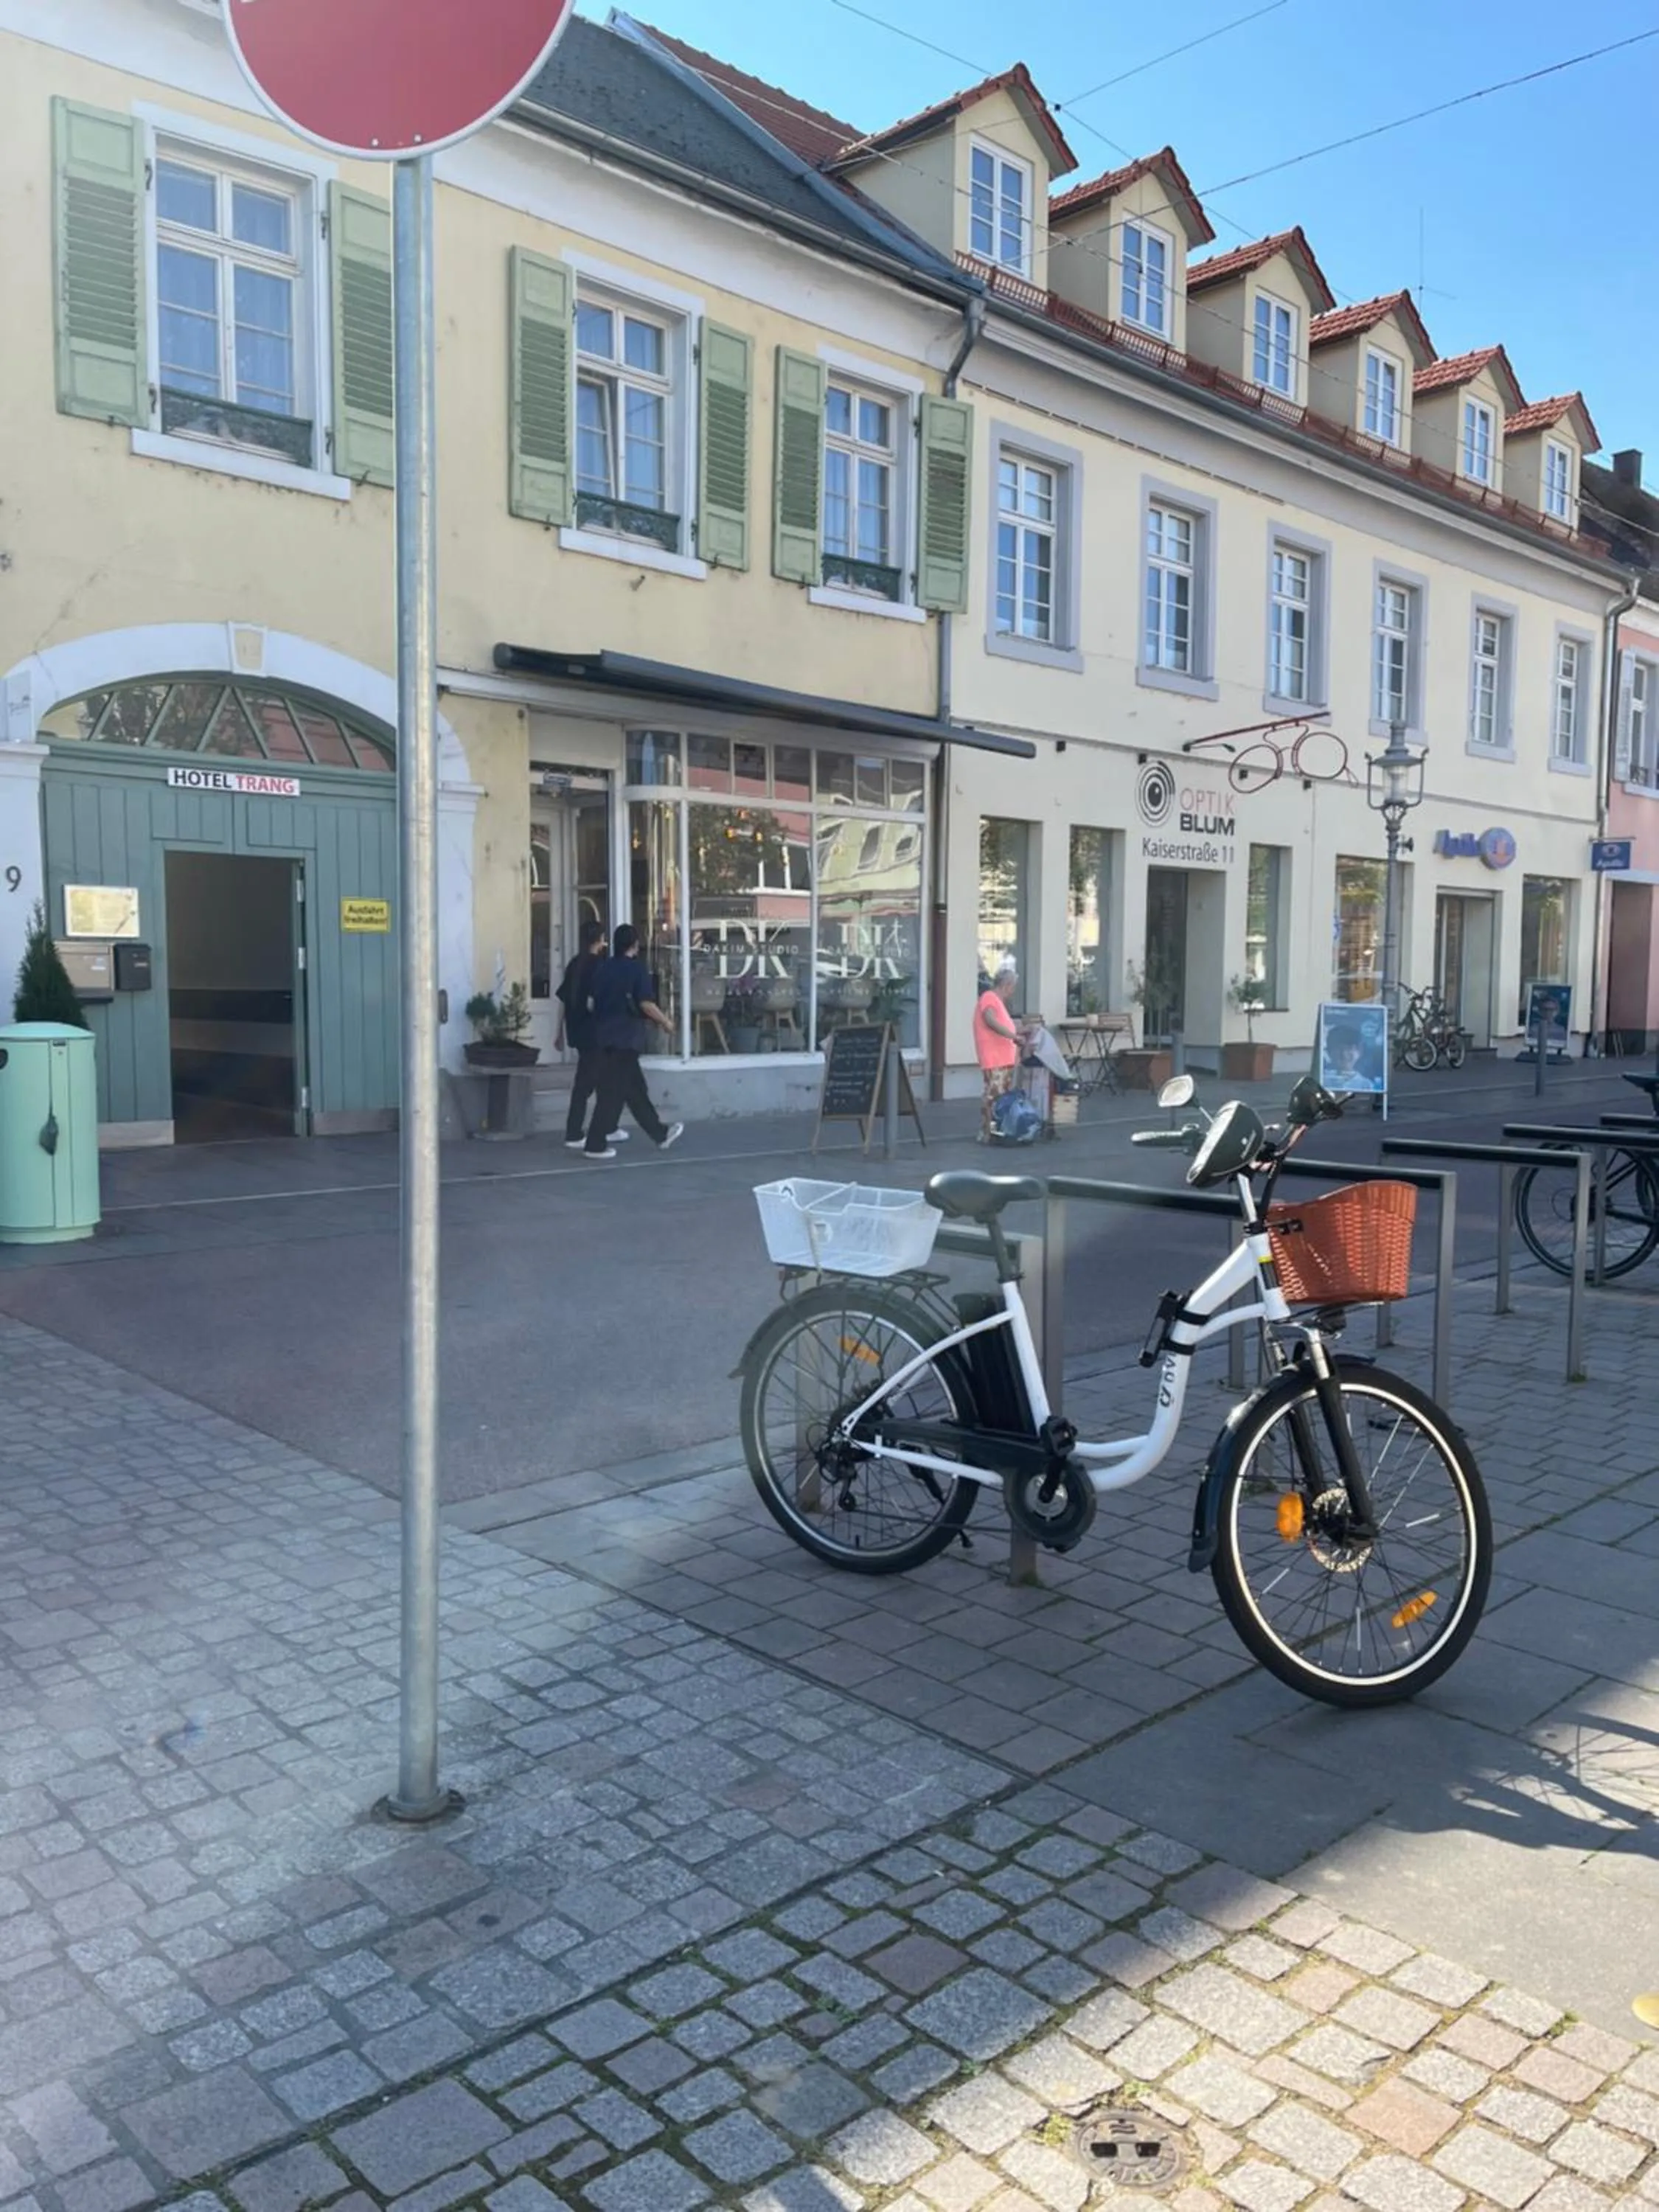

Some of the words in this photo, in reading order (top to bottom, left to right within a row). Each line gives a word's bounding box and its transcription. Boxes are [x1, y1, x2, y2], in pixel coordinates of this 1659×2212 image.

[174, 770, 232, 788] HOTEL
[236, 775, 294, 793] TRANG
[1180, 787, 1235, 815] OPTIK
[1180, 813, 1235, 835] BLUM
[1142, 837, 1218, 863] Kaiserstraße
[1222, 845, 1234, 863] 11
[6, 866, 21, 893] 9
[347, 904, 384, 914] Ausfahrt
[714, 919, 793, 979] DK
[837, 922, 905, 979] DK
